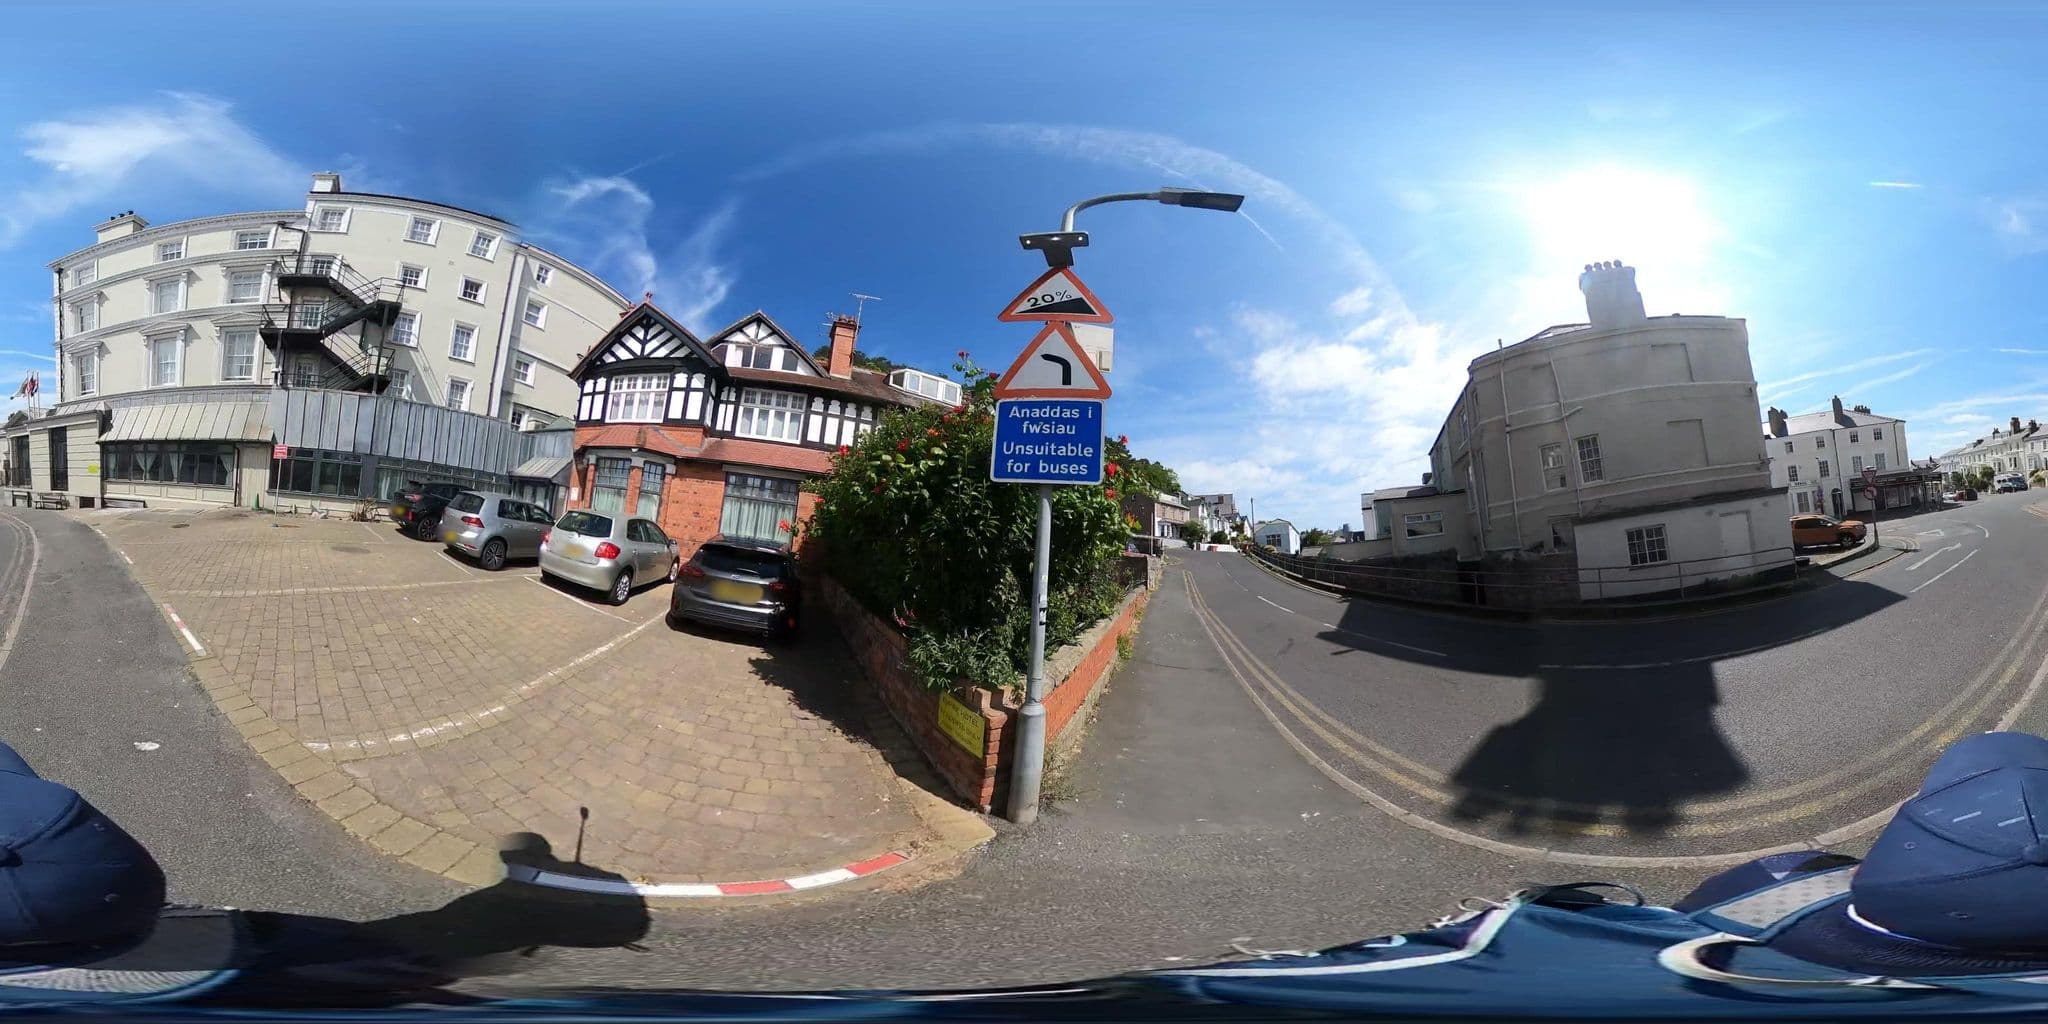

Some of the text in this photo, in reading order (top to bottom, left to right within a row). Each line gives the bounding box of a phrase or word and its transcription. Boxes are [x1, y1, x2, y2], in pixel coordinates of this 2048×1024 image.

[1027, 290, 1072, 307] 20%
[1009, 405, 1092, 419] Anaddas i
[1003, 441, 1094, 457] Unsuitable
[1007, 459, 1088, 475] for buses
